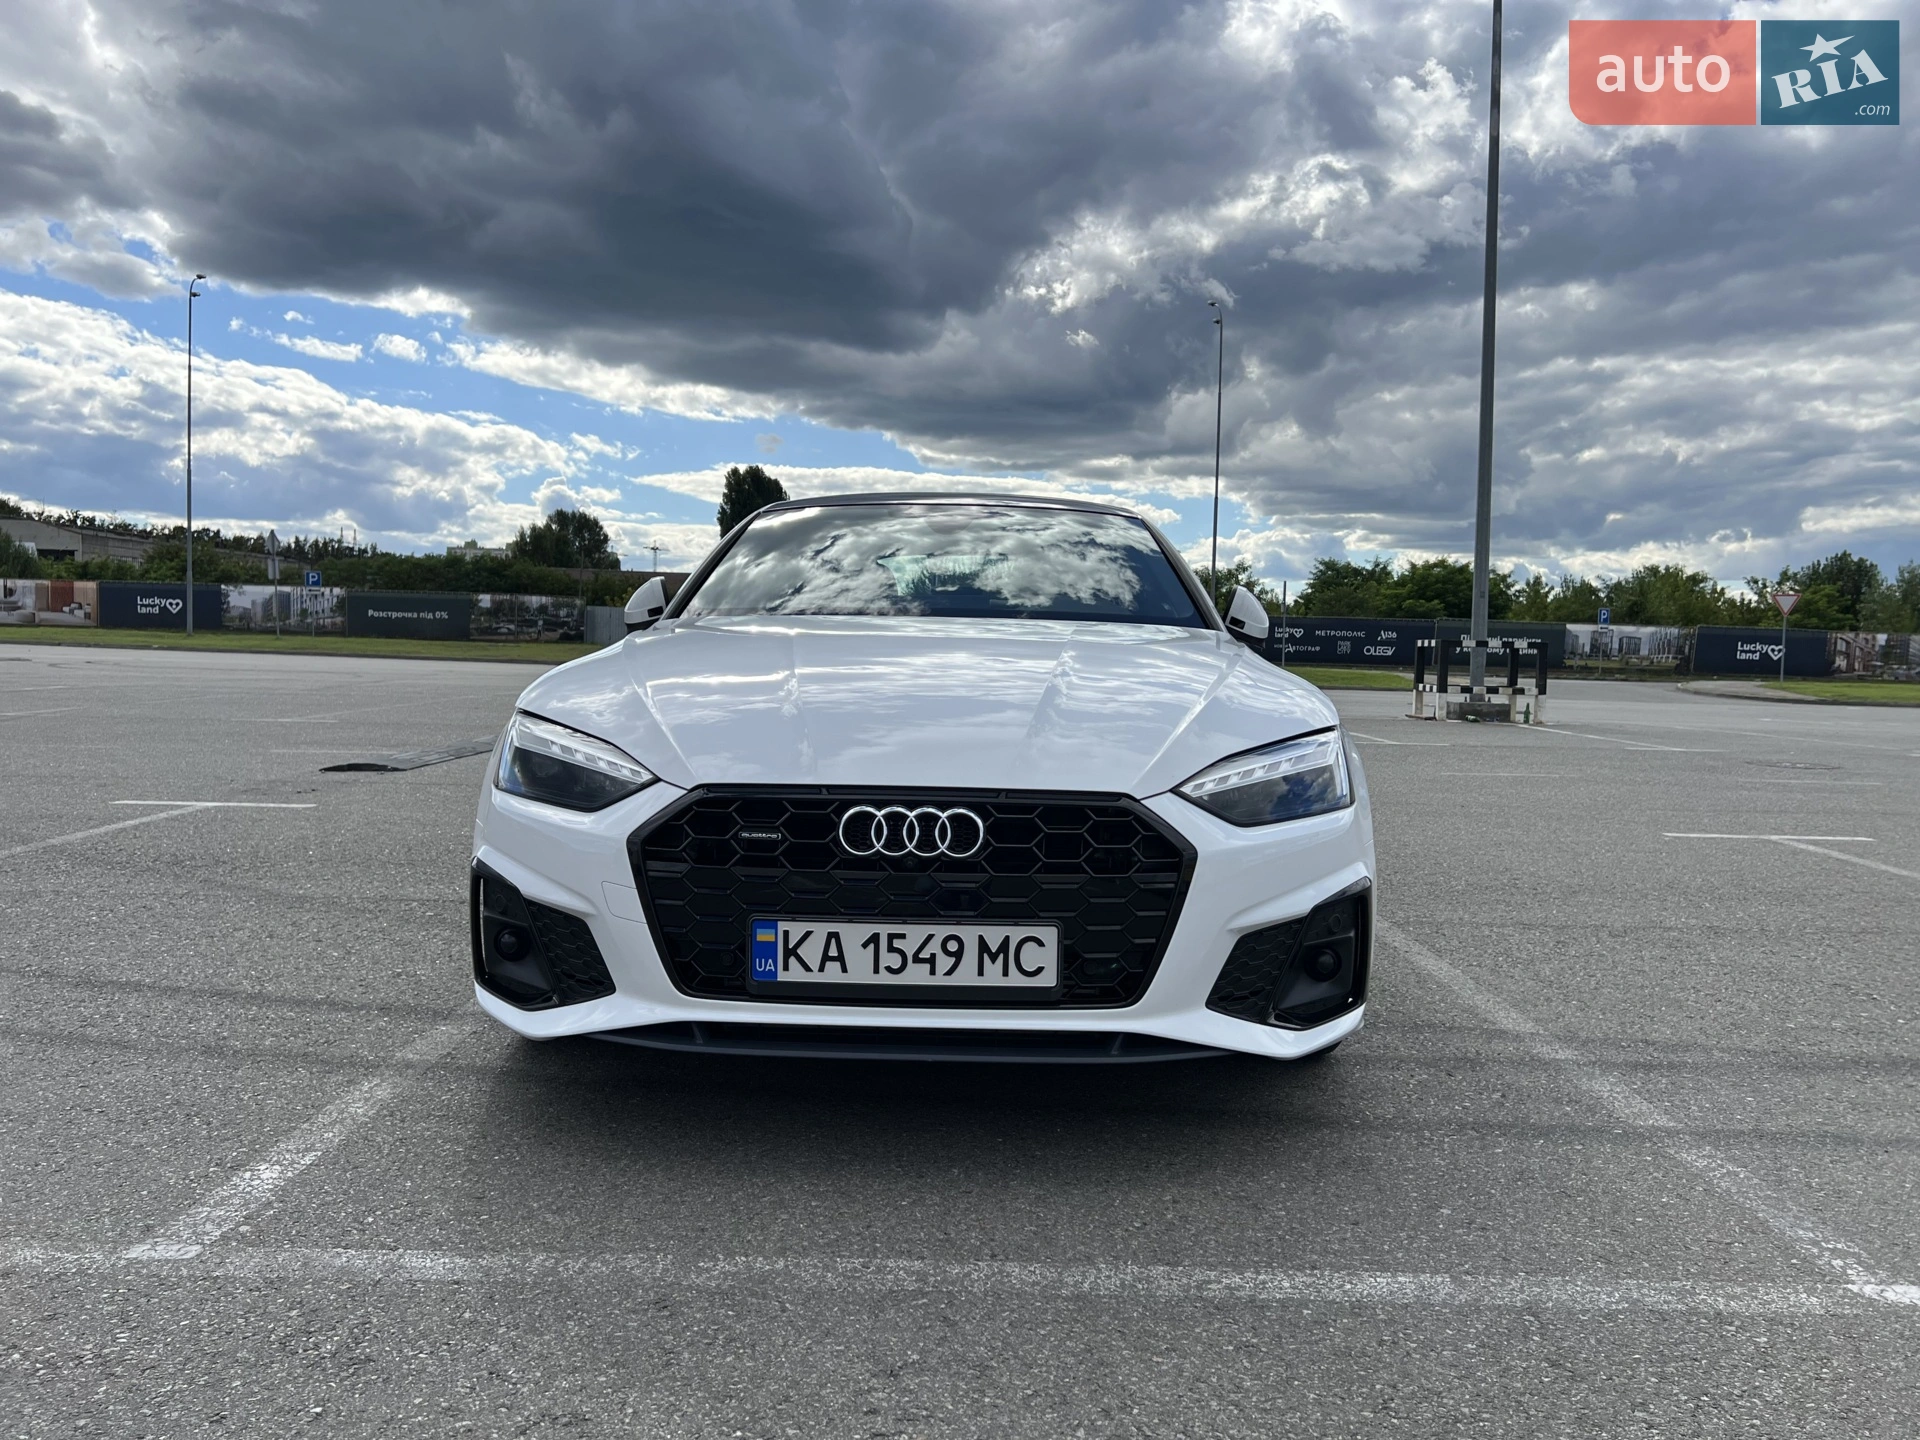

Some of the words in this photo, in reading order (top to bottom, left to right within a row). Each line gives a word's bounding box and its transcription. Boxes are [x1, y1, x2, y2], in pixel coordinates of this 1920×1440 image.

[309, 573, 318, 585] P
[137, 596, 166, 607] Lucky
[137, 605, 159, 614] land
[367, 608, 418, 619] Розстрочка
[419, 611, 434, 620] під
[435, 611, 449, 619] 0%
[1737, 641, 1769, 653] Lucky
[1736, 650, 1760, 660] land
[782, 929, 848, 973] KA
[860, 931, 965, 976] 1549
[977, 933, 1046, 978] MC
[755, 958, 775, 972] UA
